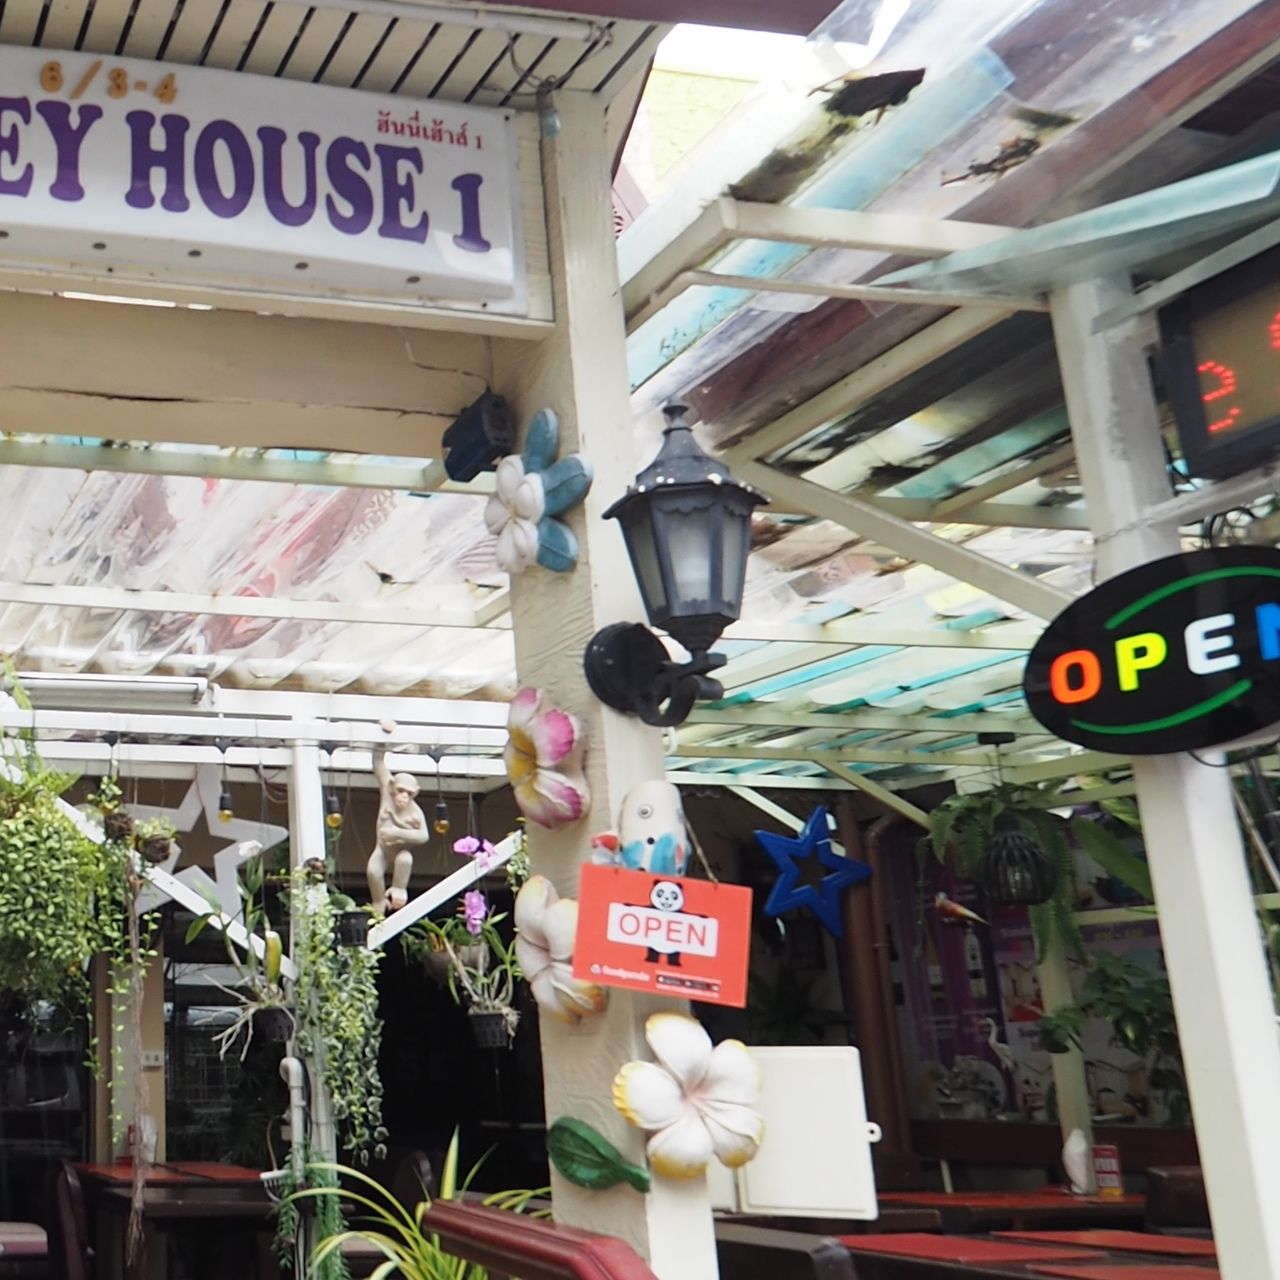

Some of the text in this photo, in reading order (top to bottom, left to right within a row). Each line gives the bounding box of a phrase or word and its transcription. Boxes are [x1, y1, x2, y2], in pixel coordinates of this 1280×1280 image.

[124, 109, 430, 244] HOUSE
[452, 173, 490, 253] 1
[620, 913, 706, 947] OPEN
